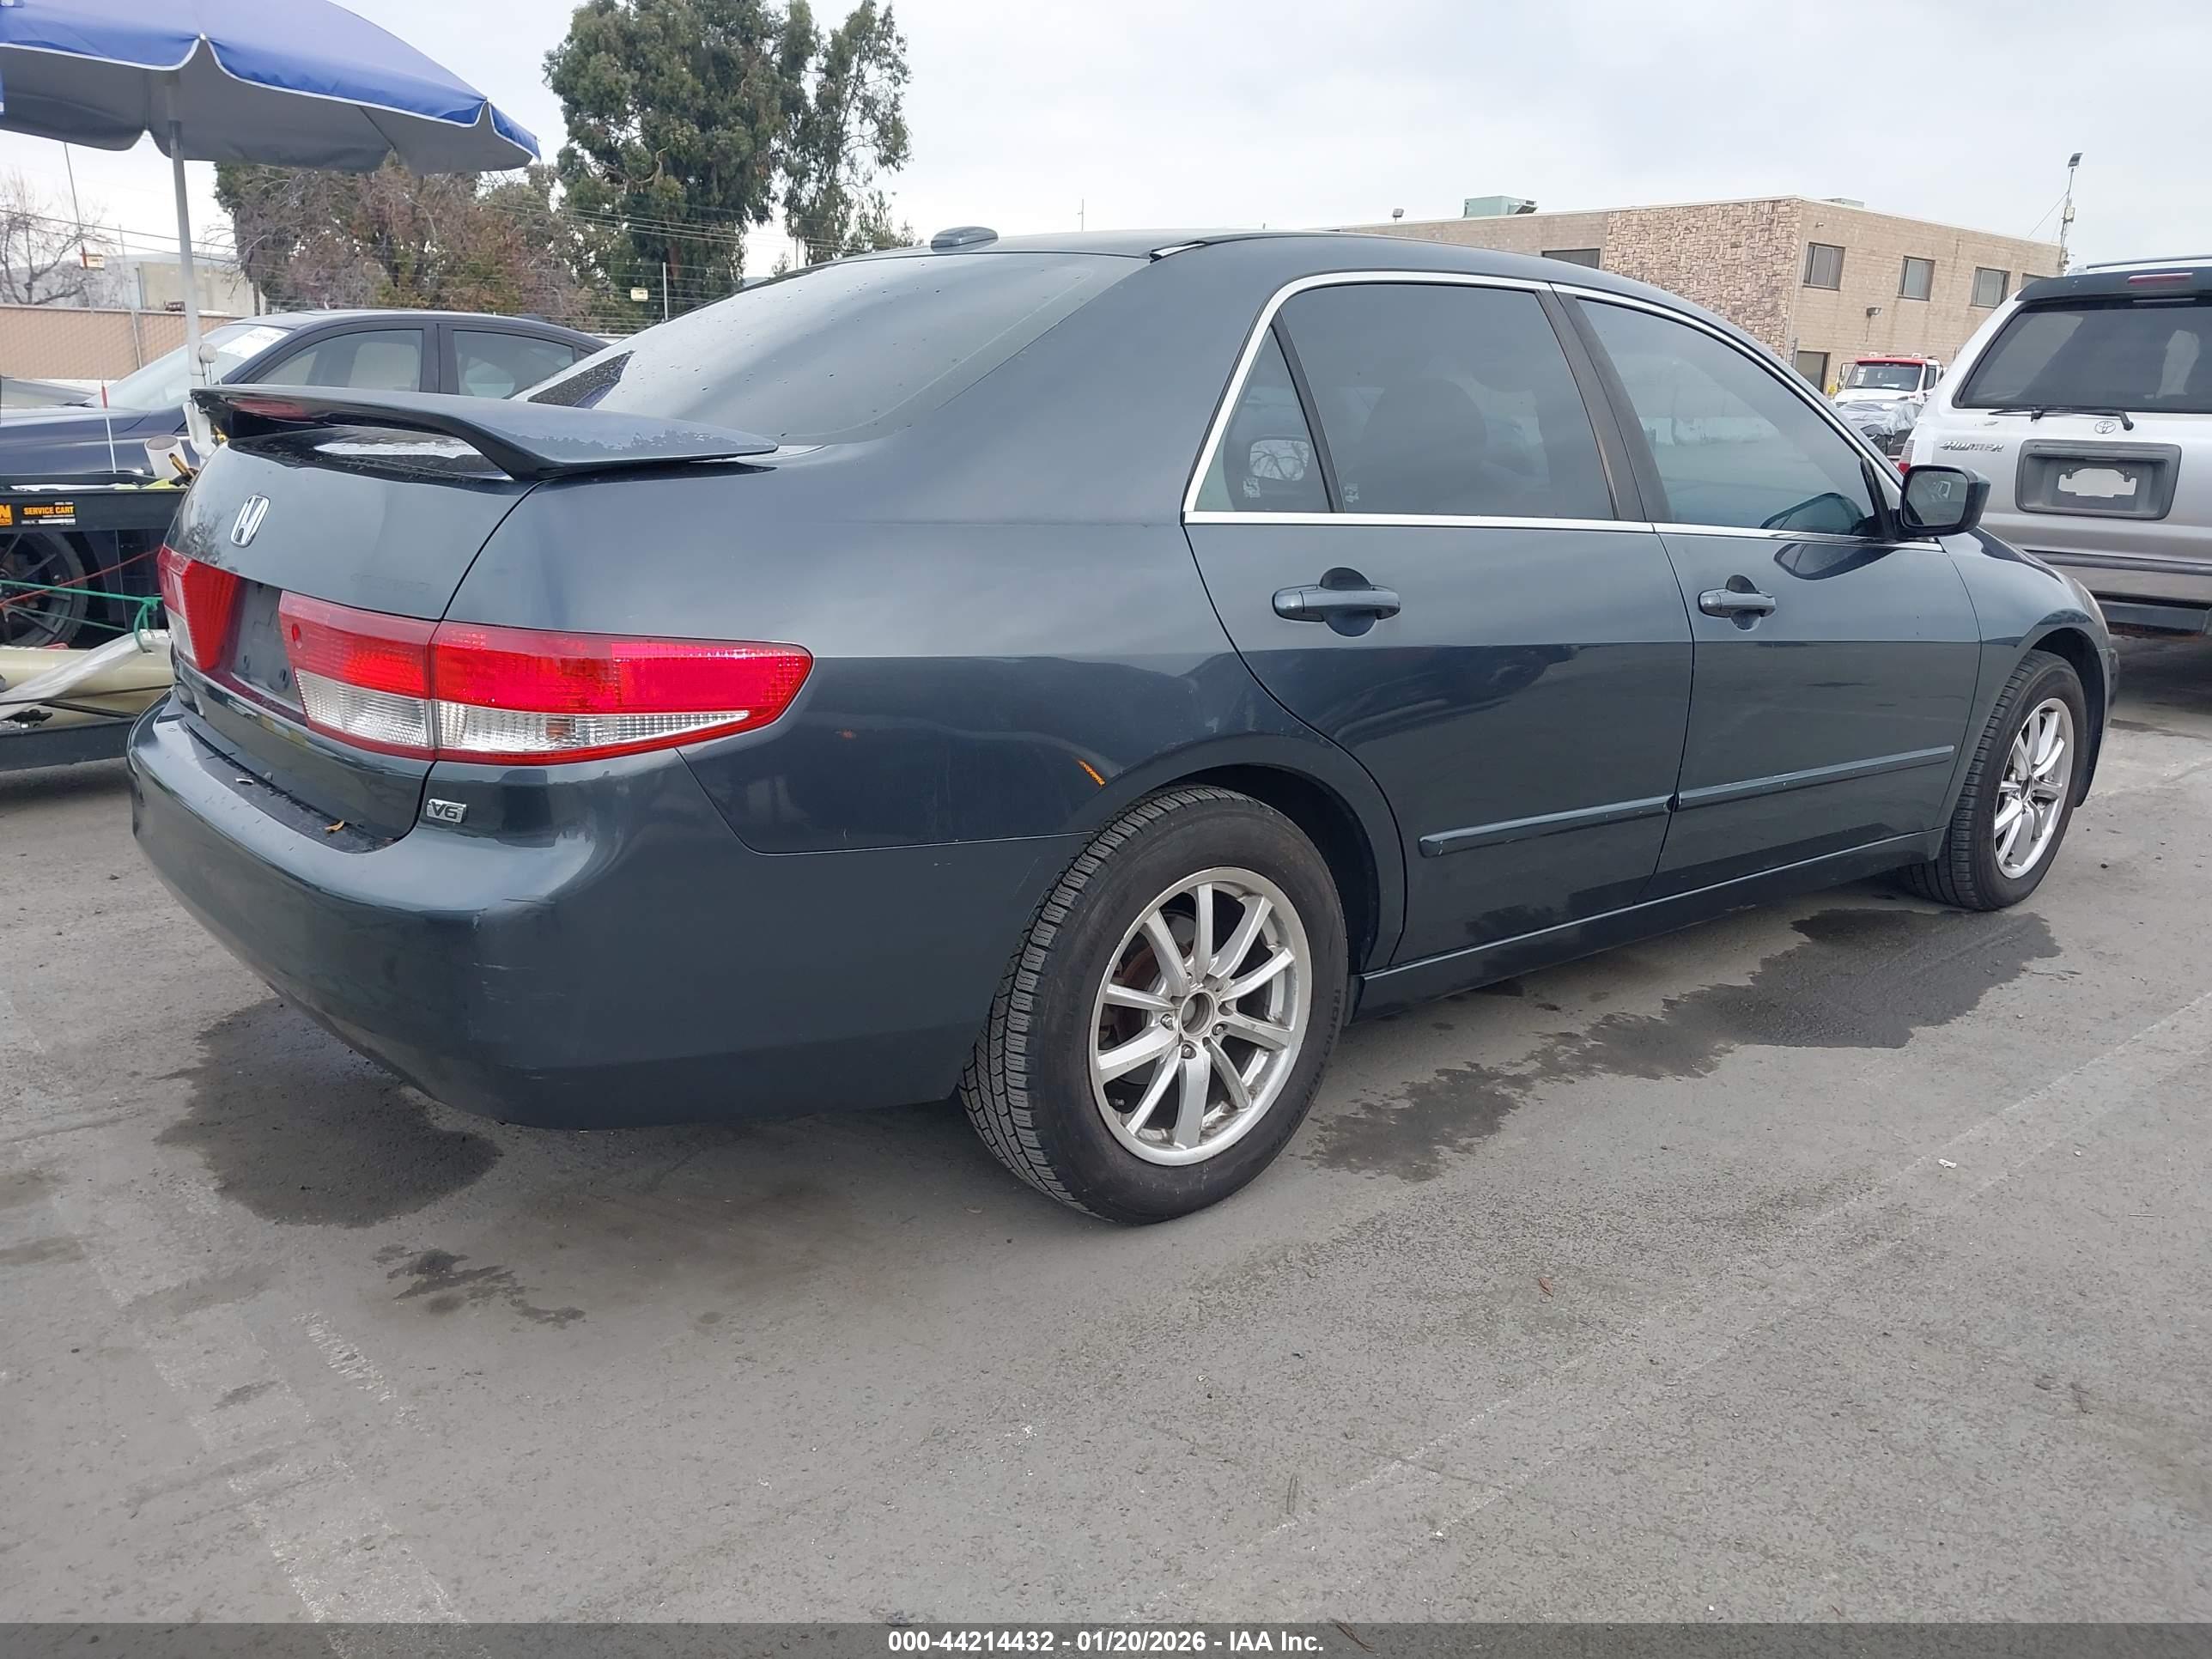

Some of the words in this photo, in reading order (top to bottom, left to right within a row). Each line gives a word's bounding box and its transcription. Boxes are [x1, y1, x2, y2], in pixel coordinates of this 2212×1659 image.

[23, 507, 54, 515] SERVICE
[55, 506, 74, 514] CART
[430, 801, 459, 820] V6
